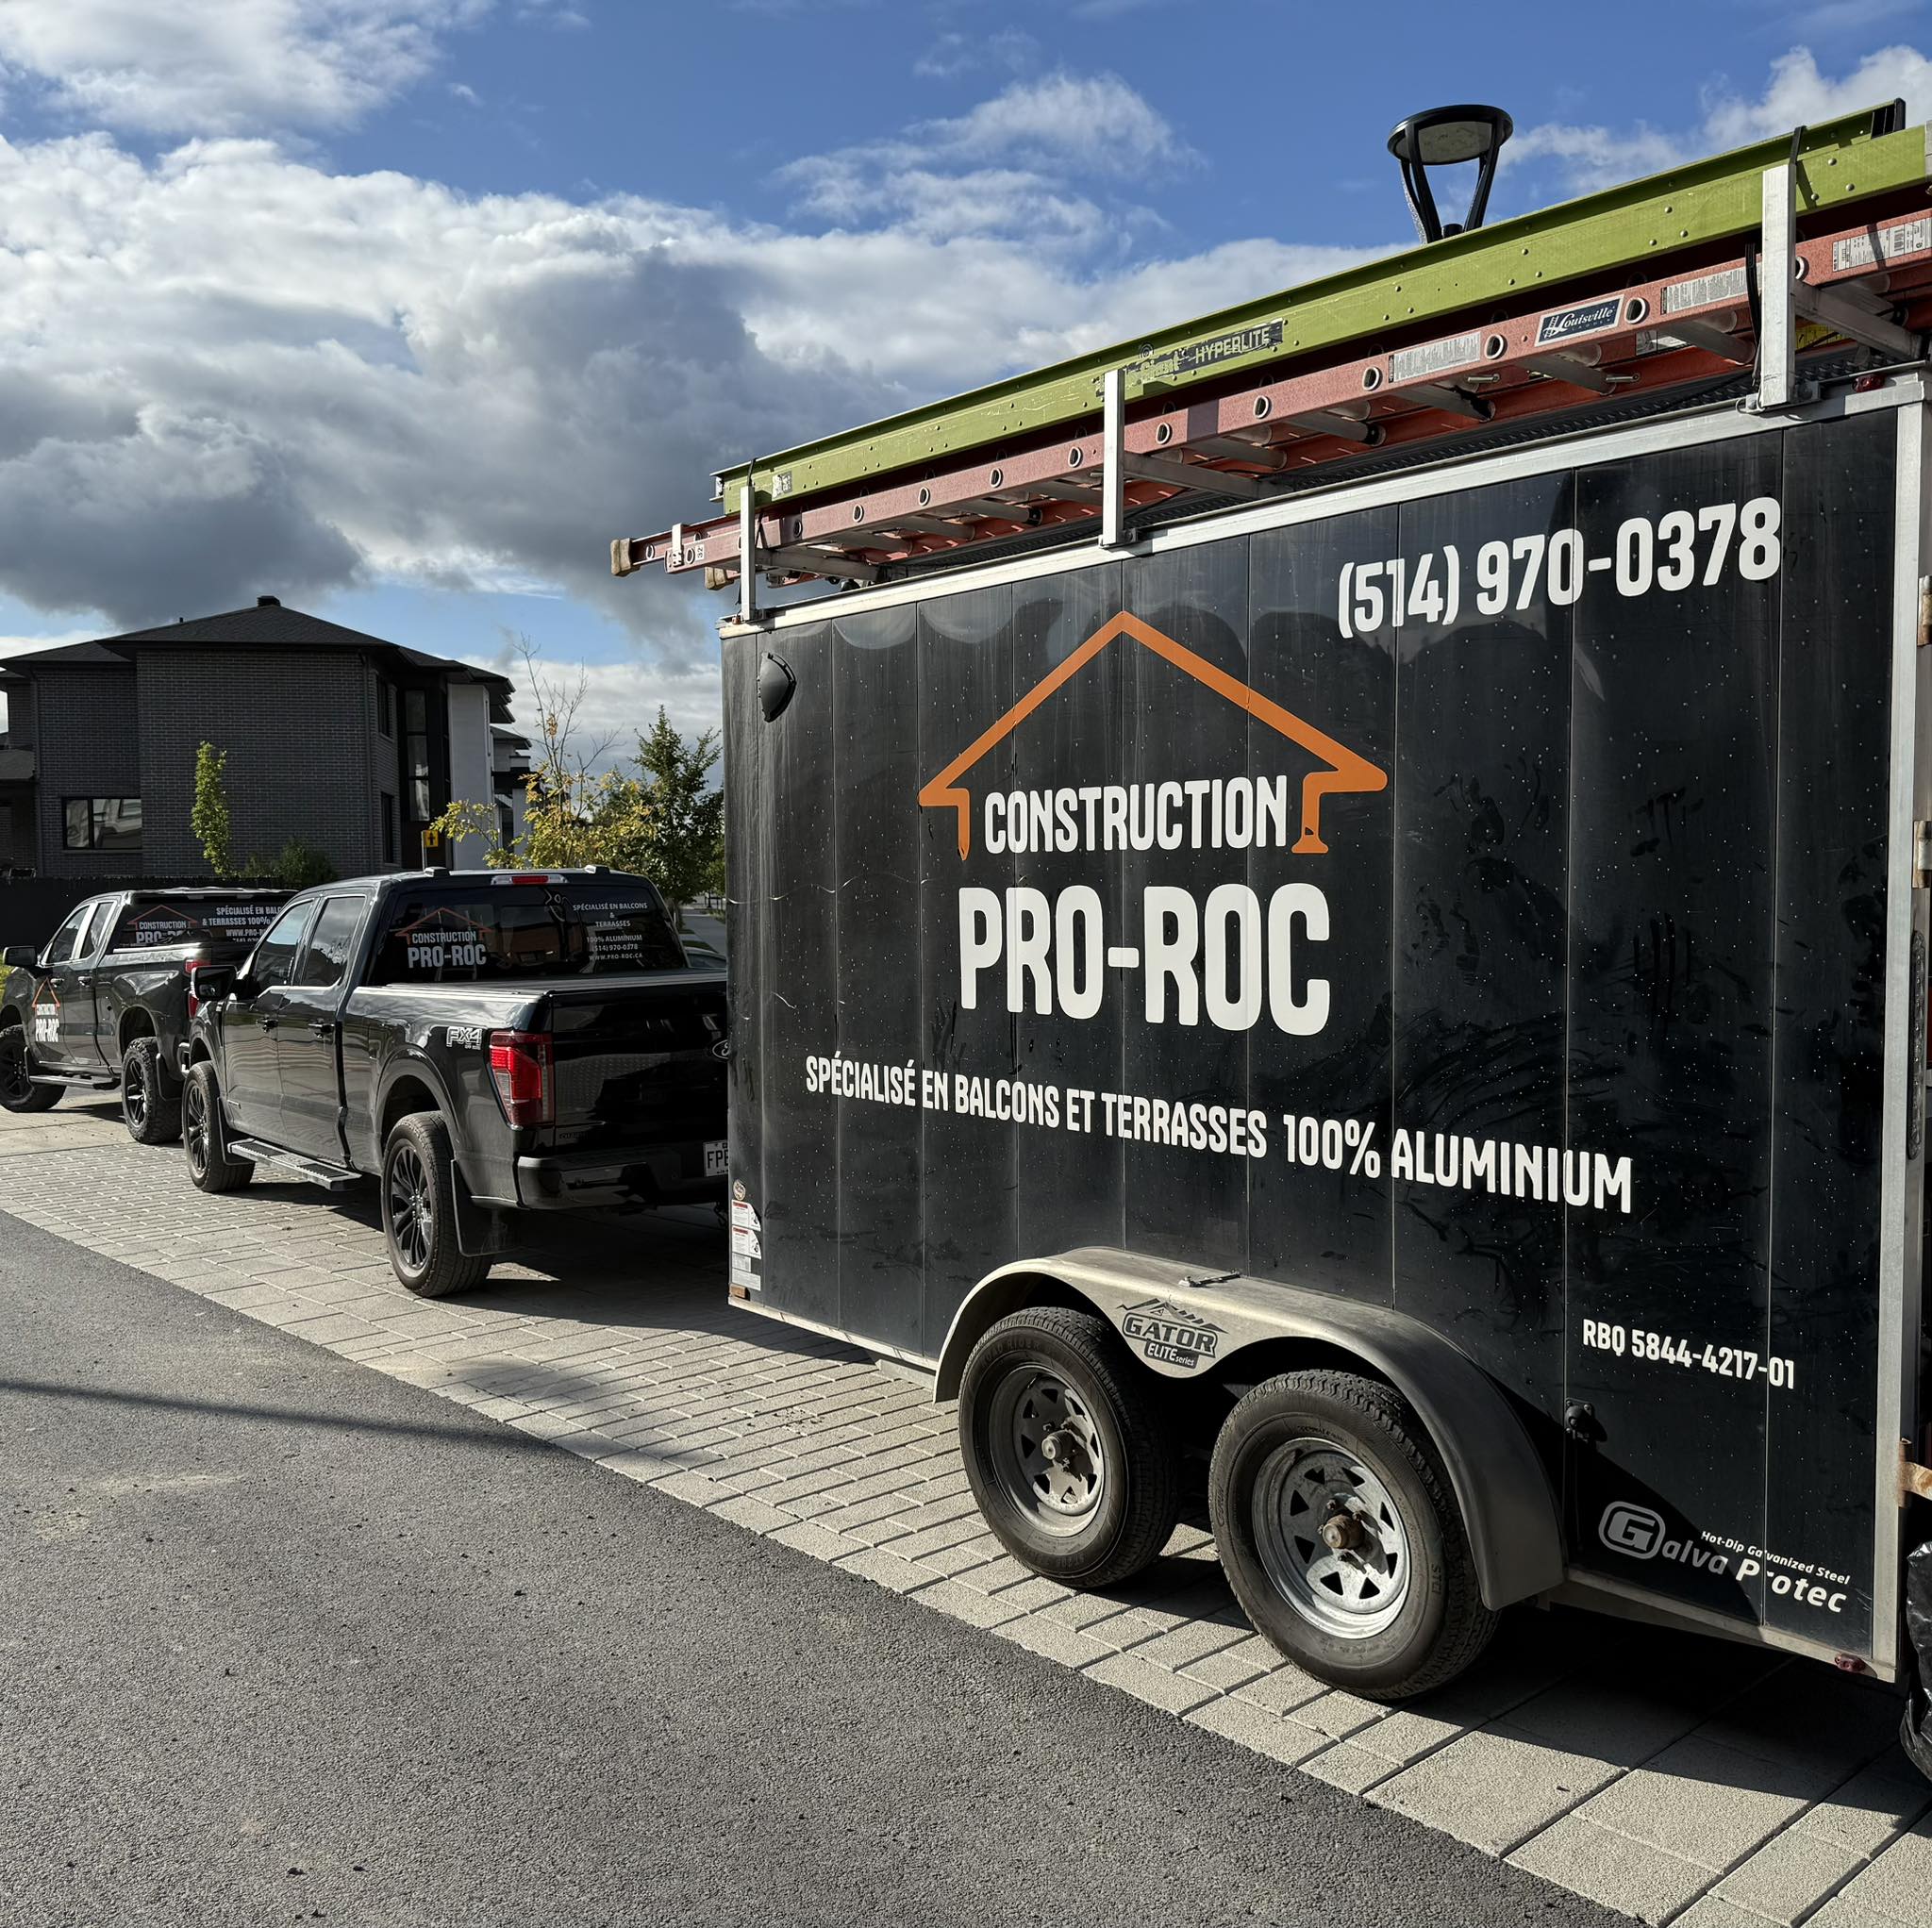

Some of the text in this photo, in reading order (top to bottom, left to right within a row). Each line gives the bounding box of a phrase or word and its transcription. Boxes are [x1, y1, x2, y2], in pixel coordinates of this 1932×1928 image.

[1542, 307, 1613, 339] Louisville
[1195, 325, 1273, 364] HYPERLITE
[1339, 496, 1781, 639] (514) 970-0378
[984, 775, 1288, 854] CONSTRUCTION
[208, 917, 246, 926] TERRASSES
[248, 916, 271, 925] 100%
[216, 905, 255, 916] SPÉCIALISÉ
[619, 902, 648, 910] BALCONS
[139, 921, 187, 930] CONSTRUCTION
[412, 931, 476, 944] CONSTRUCTION
[408, 944, 487, 969] PRO-ROC
[958, 883, 1331, 1036] PRO-ROC
[446, 1026, 482, 1047] FX4
[806, 1051, 1633, 1214] SPÉCIALISÉ EN BALCONS ET TERRASSES 100% ALUMINIUM
[1124, 1317, 1215, 1353] GATOR
[1147, 1342, 1195, 1367] ELITE series
[1582, 1319, 1794, 1389] RBQ 5844-4217-01
[1607, 1509, 1847, 1613] Galva Potec
[1701, 1530, 1851, 1586] Hot-Dip Gavanized Steel
